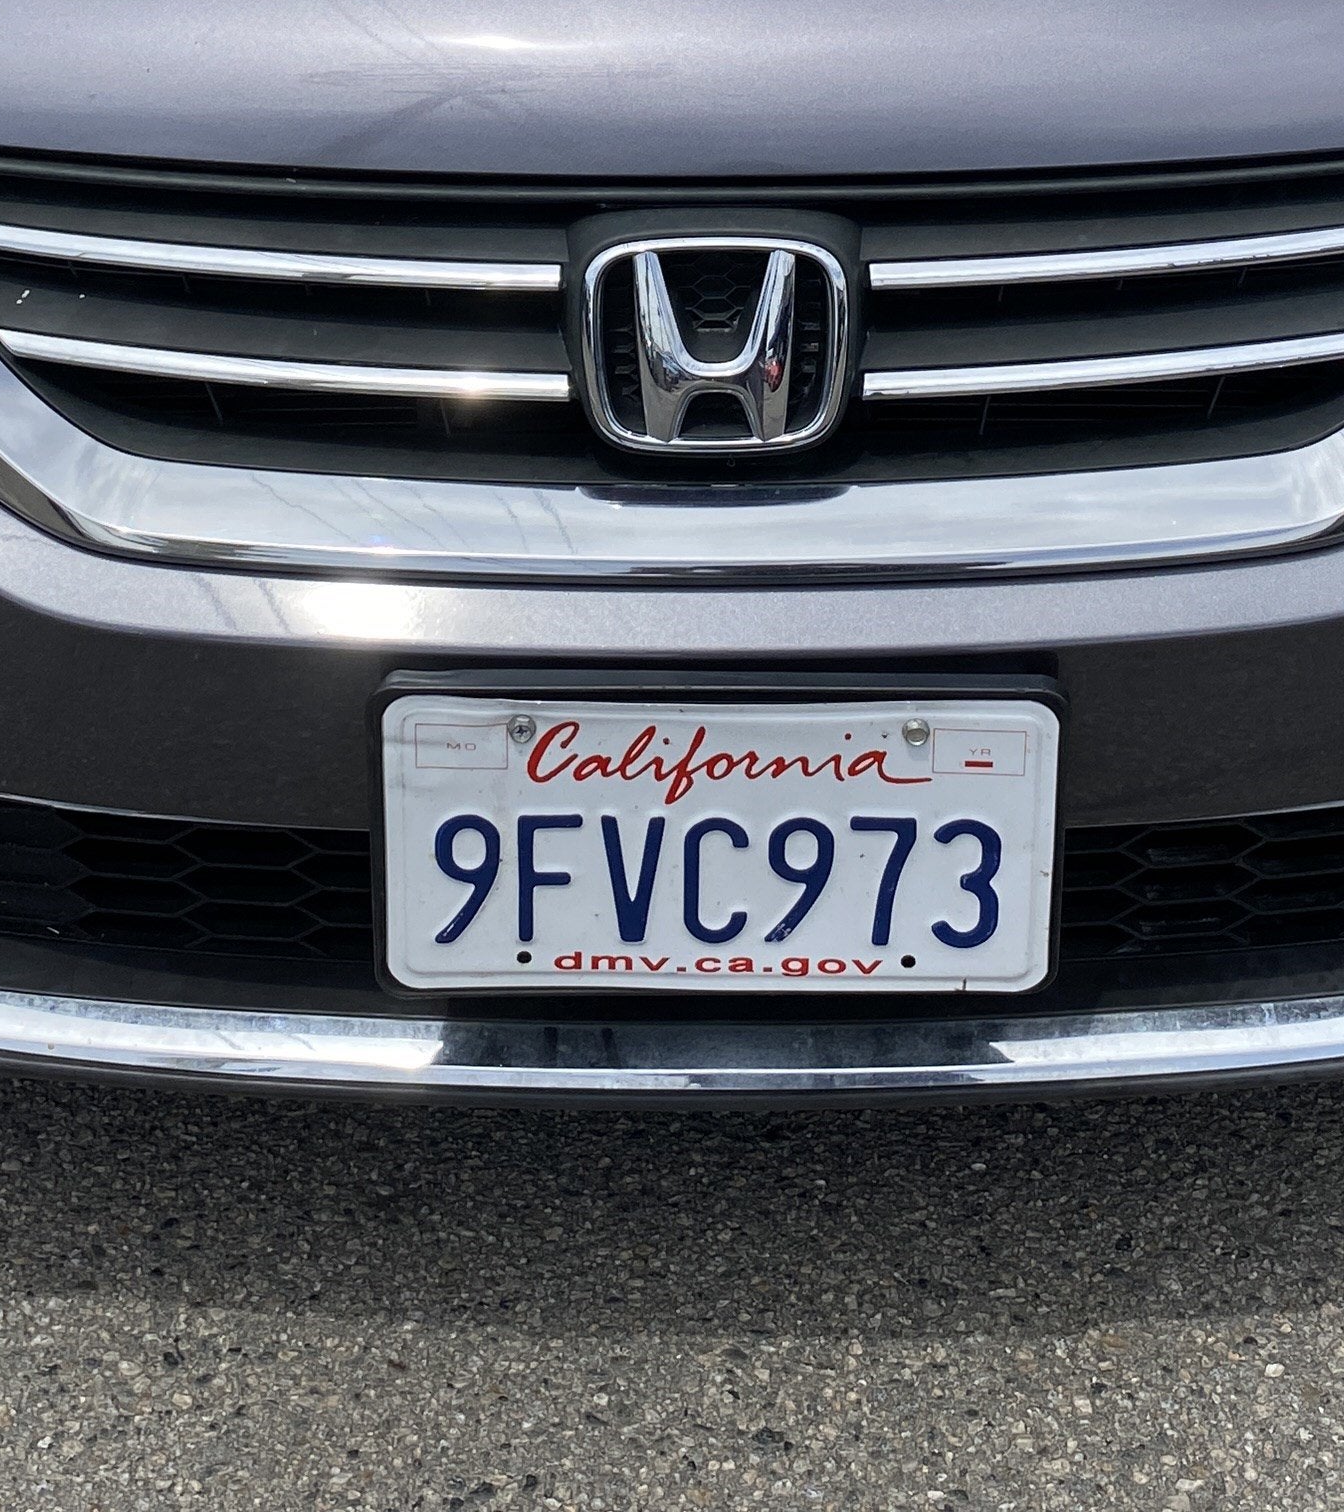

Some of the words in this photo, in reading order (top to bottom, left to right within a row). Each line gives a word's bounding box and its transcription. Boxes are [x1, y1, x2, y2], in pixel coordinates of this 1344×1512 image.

[446, 741, 477, 751] MO
[968, 748, 992, 757] YR
[526, 720, 933, 805] California
[433, 813, 1003, 949] 9FVC973
[553, 949, 884, 977] dmv.ca.gov
